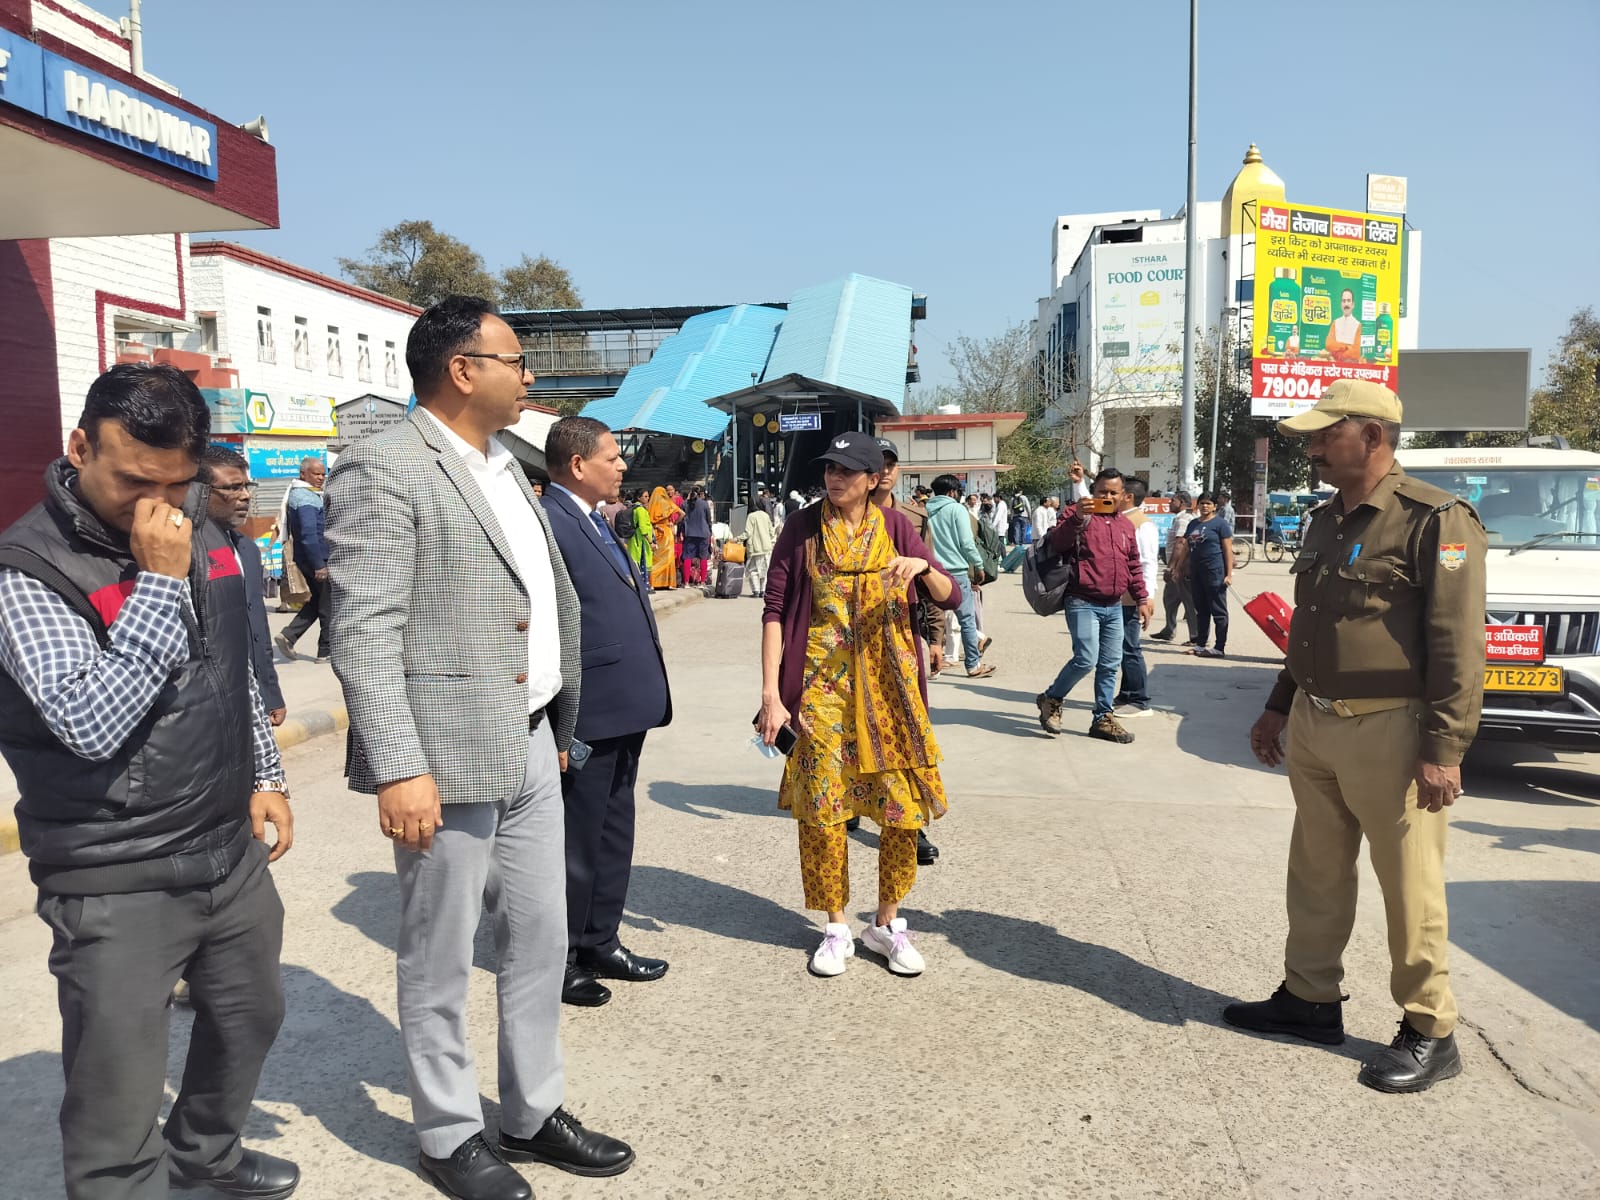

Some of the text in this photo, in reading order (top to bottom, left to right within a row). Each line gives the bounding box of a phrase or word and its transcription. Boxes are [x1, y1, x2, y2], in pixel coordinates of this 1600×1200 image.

[64, 70, 211, 166] HARIDWAR
[1261, 208, 1397, 242] गैस तेजाब कब्ज लिवर
[1271, 235, 1286, 246] इस
[1289, 235, 1306, 247] किट
[1309, 238, 1321, 249] को
[1325, 242, 1363, 254] अपनाकर
[1267, 247, 1295, 258] व्यक्ति
[1297, 248, 1308, 261] भी
[1351, 257, 1377, 268] सकता
[1108, 271, 1142, 285] FOOD
[1261, 363, 1278, 374] पास
[1279, 361, 1289, 374] के
[1290, 361, 1322, 376] मेडिकल
[1342, 367, 1353, 378] पर
[1494, 628, 1539, 642] अधिकारी
[1485, 670, 1559, 687] 7TE2273
